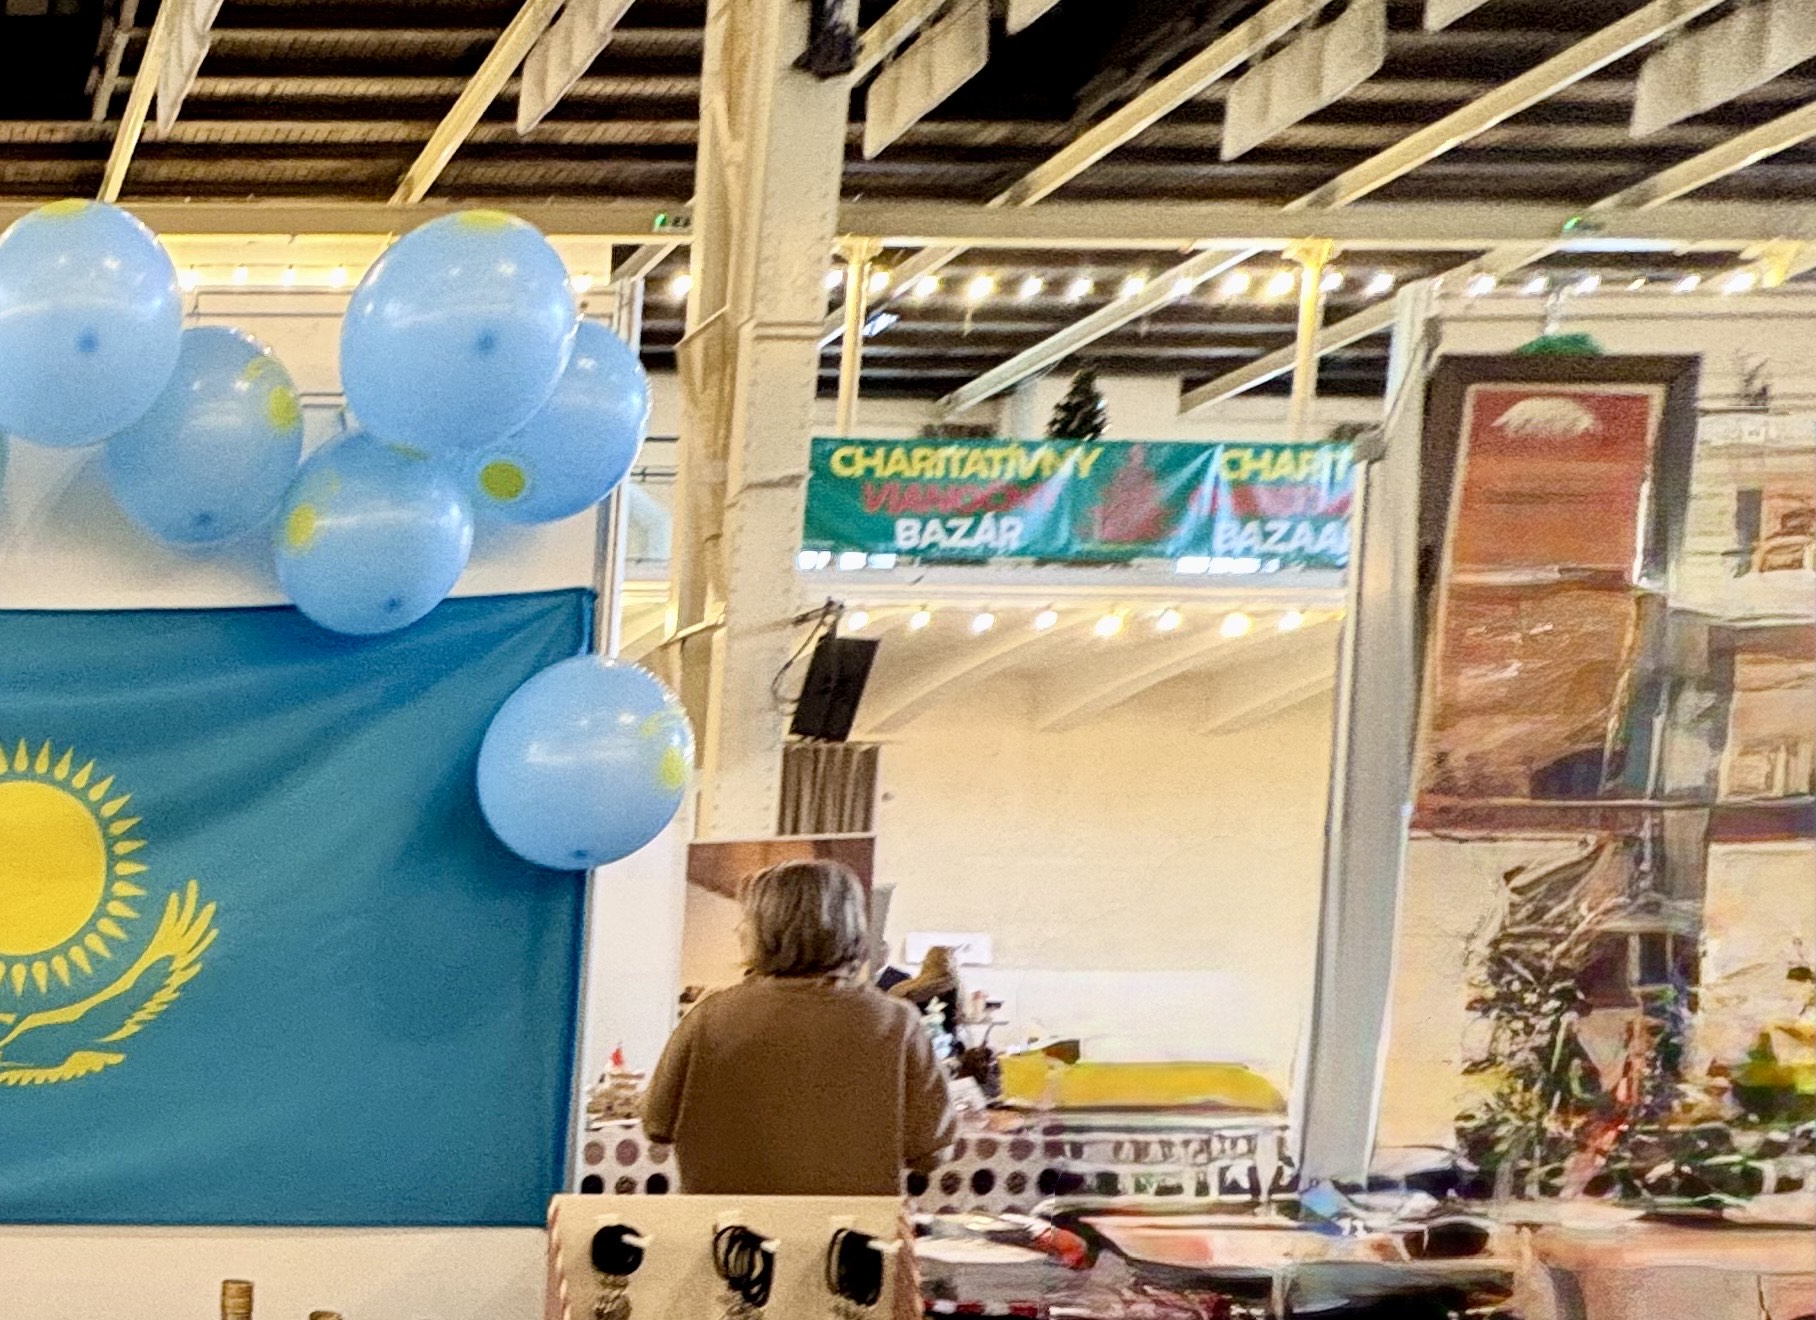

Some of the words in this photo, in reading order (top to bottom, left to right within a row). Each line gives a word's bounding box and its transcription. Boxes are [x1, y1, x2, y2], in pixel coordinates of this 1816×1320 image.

[1220, 446, 1357, 481] CHARIT
[894, 511, 1025, 549] BAZÁR
[1212, 517, 1353, 556] BAZAA
